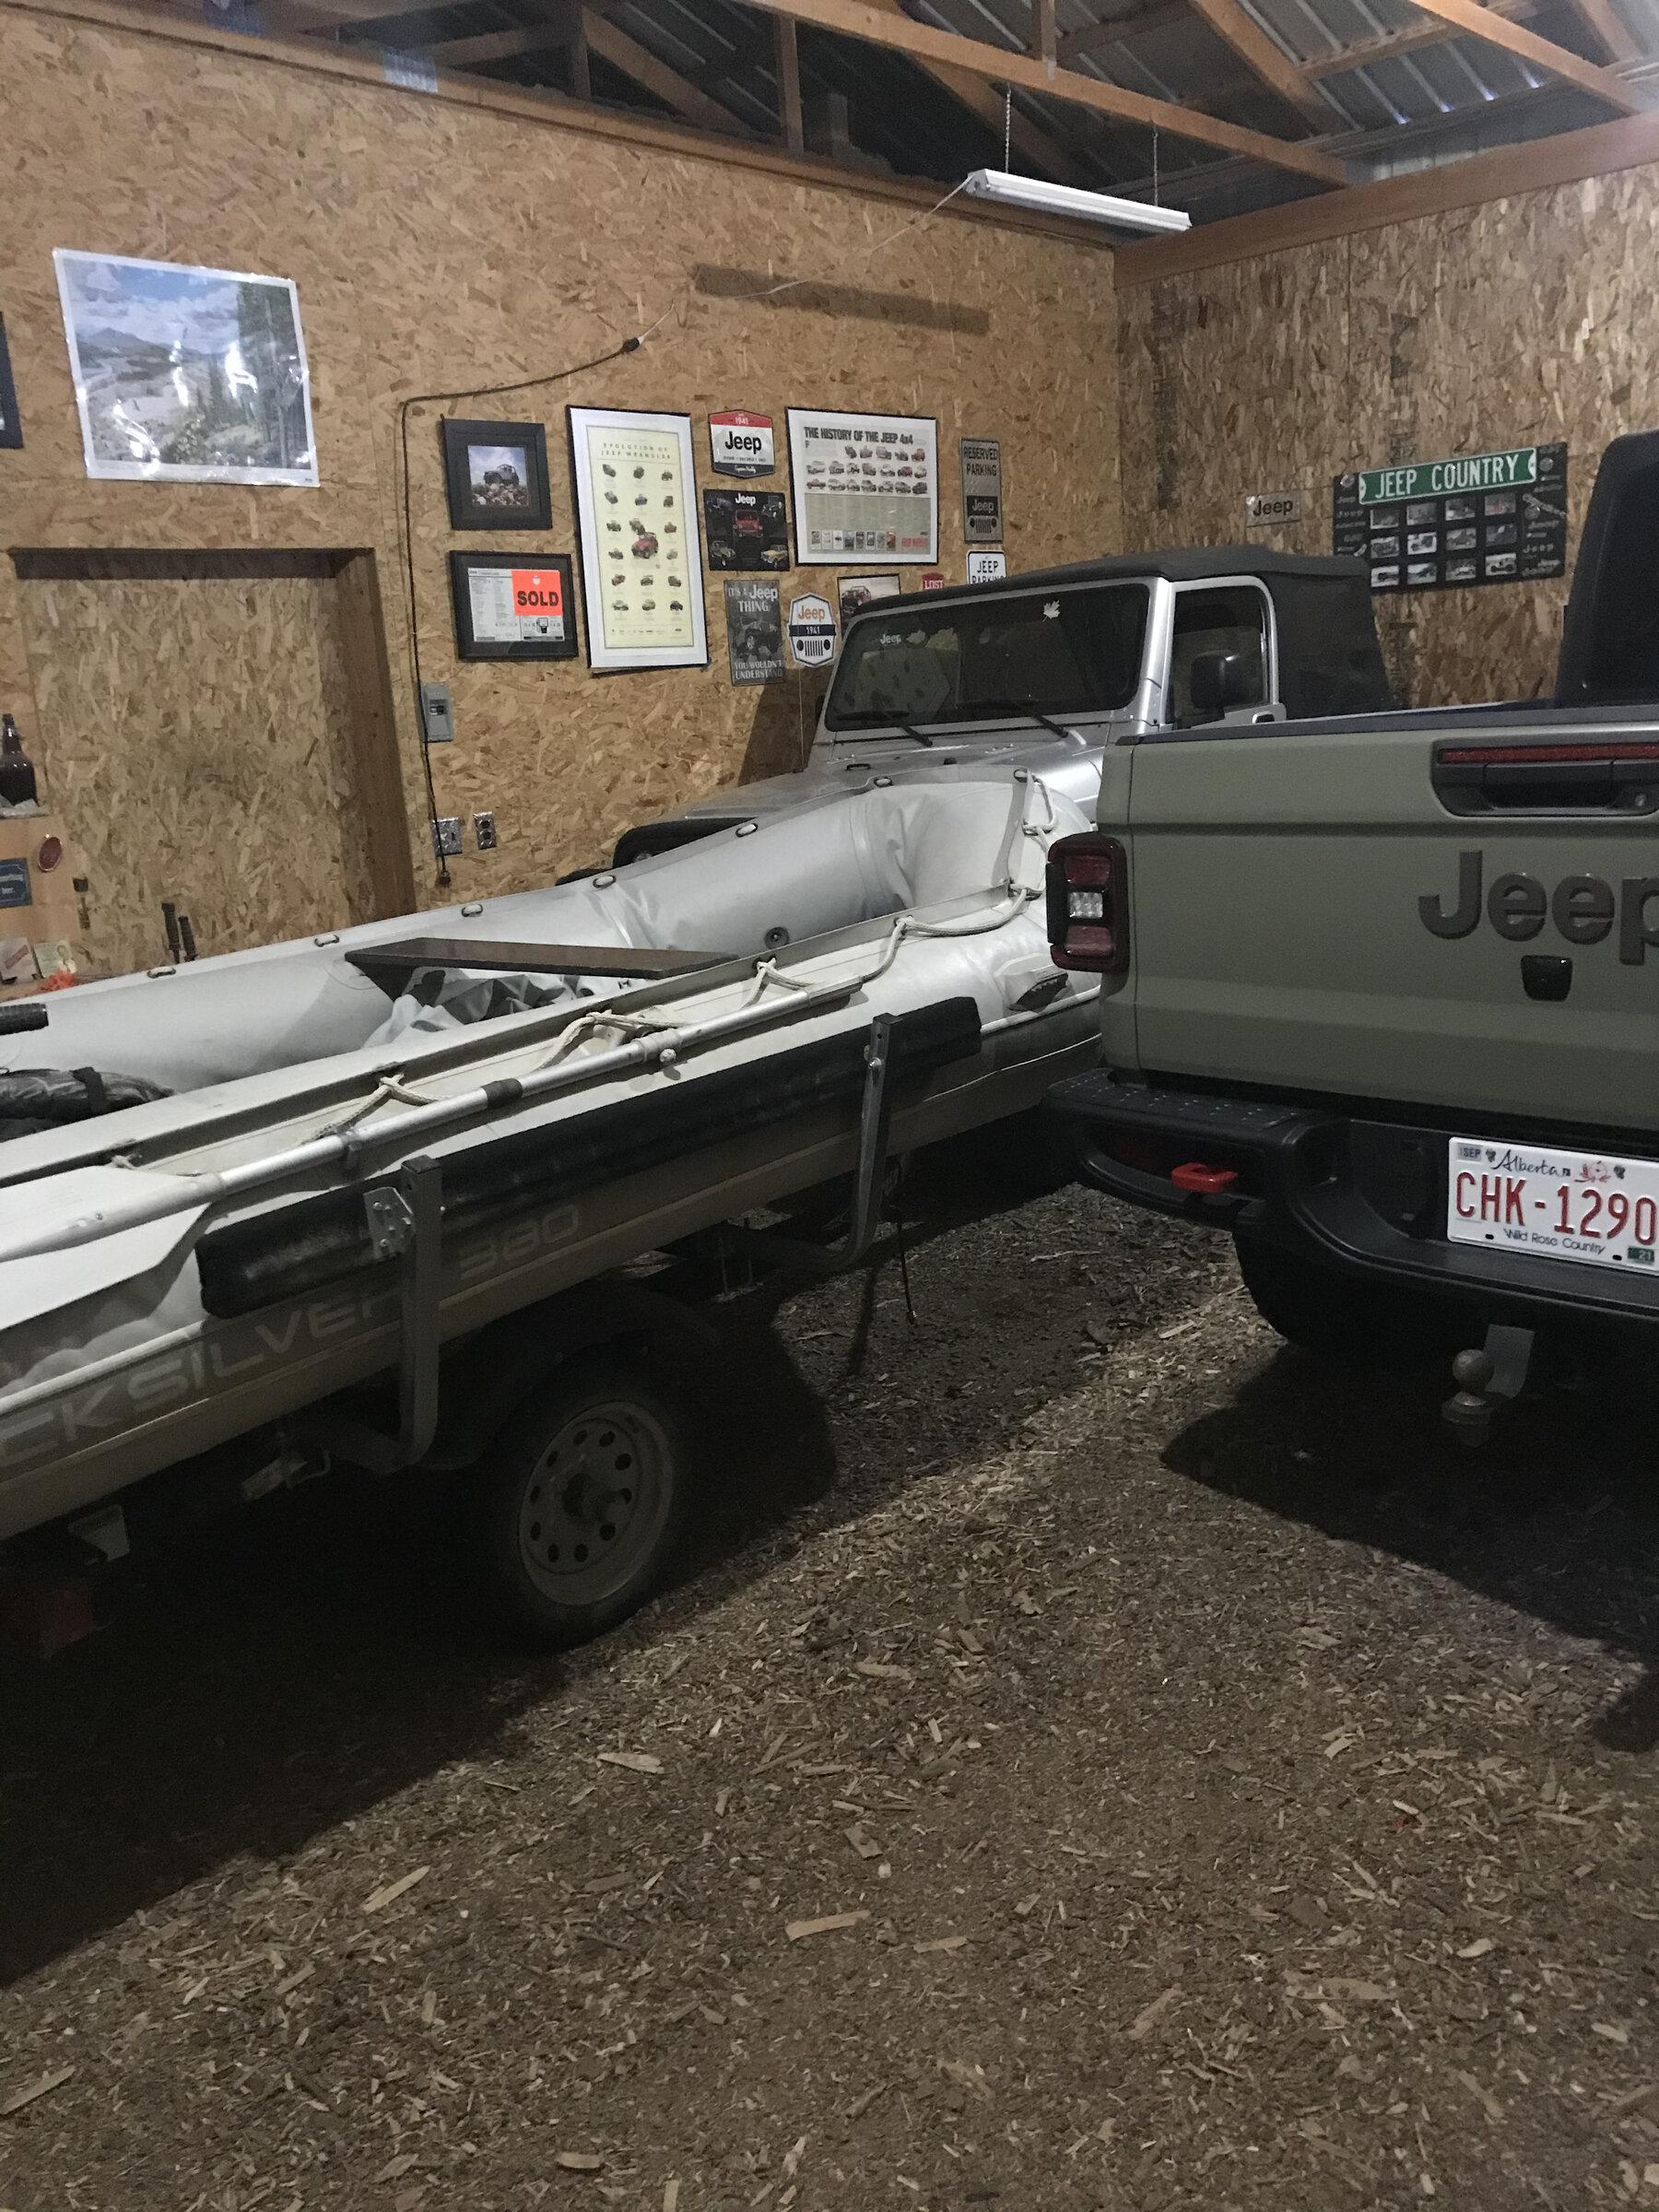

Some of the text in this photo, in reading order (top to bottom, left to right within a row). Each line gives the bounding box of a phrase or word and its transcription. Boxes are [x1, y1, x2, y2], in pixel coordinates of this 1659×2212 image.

[735, 417, 748, 425] 1941
[724, 430, 762, 455] Jeep
[804, 426, 819, 439] THE
[820, 428, 853, 441] HISTORY
[853, 430, 864, 441] OF
[865, 430, 879, 442] THE
[881, 432, 899, 444] JEEP
[603, 442, 654, 452] EVOLUTION
[963, 446, 998, 461] RESERVED
[626, 451, 671, 460] WRANGLER
[966, 463, 997, 477] PARKING
[1374, 453, 1520, 500] JEEP COUNTRY
[735, 492, 756, 507] Jeep
[971, 499, 995, 514] Jeep
[1253, 500, 1294, 516] Jeep
[977, 560, 999, 573] JEEP
[924, 580, 944, 590] LOST
[517, 590, 559, 606] SOLD
[749, 583, 779, 603] Jeep
[738, 600, 769, 613] THING
[797, 606, 826, 622] Jeep
[879, 633, 902, 645] Jeep
[735, 661, 748, 671] YOU
[735, 668, 782, 680] UNDERSTAND
[1418, 849, 1659, 966] Jeep
[1463, 1147, 1481, 1159] SEP
[1492, 1148, 1559, 1177] Alberta
[1455, 1171, 1657, 1245] CHK-1290
[1502, 1228, 1606, 1255] Wild Rose Country
